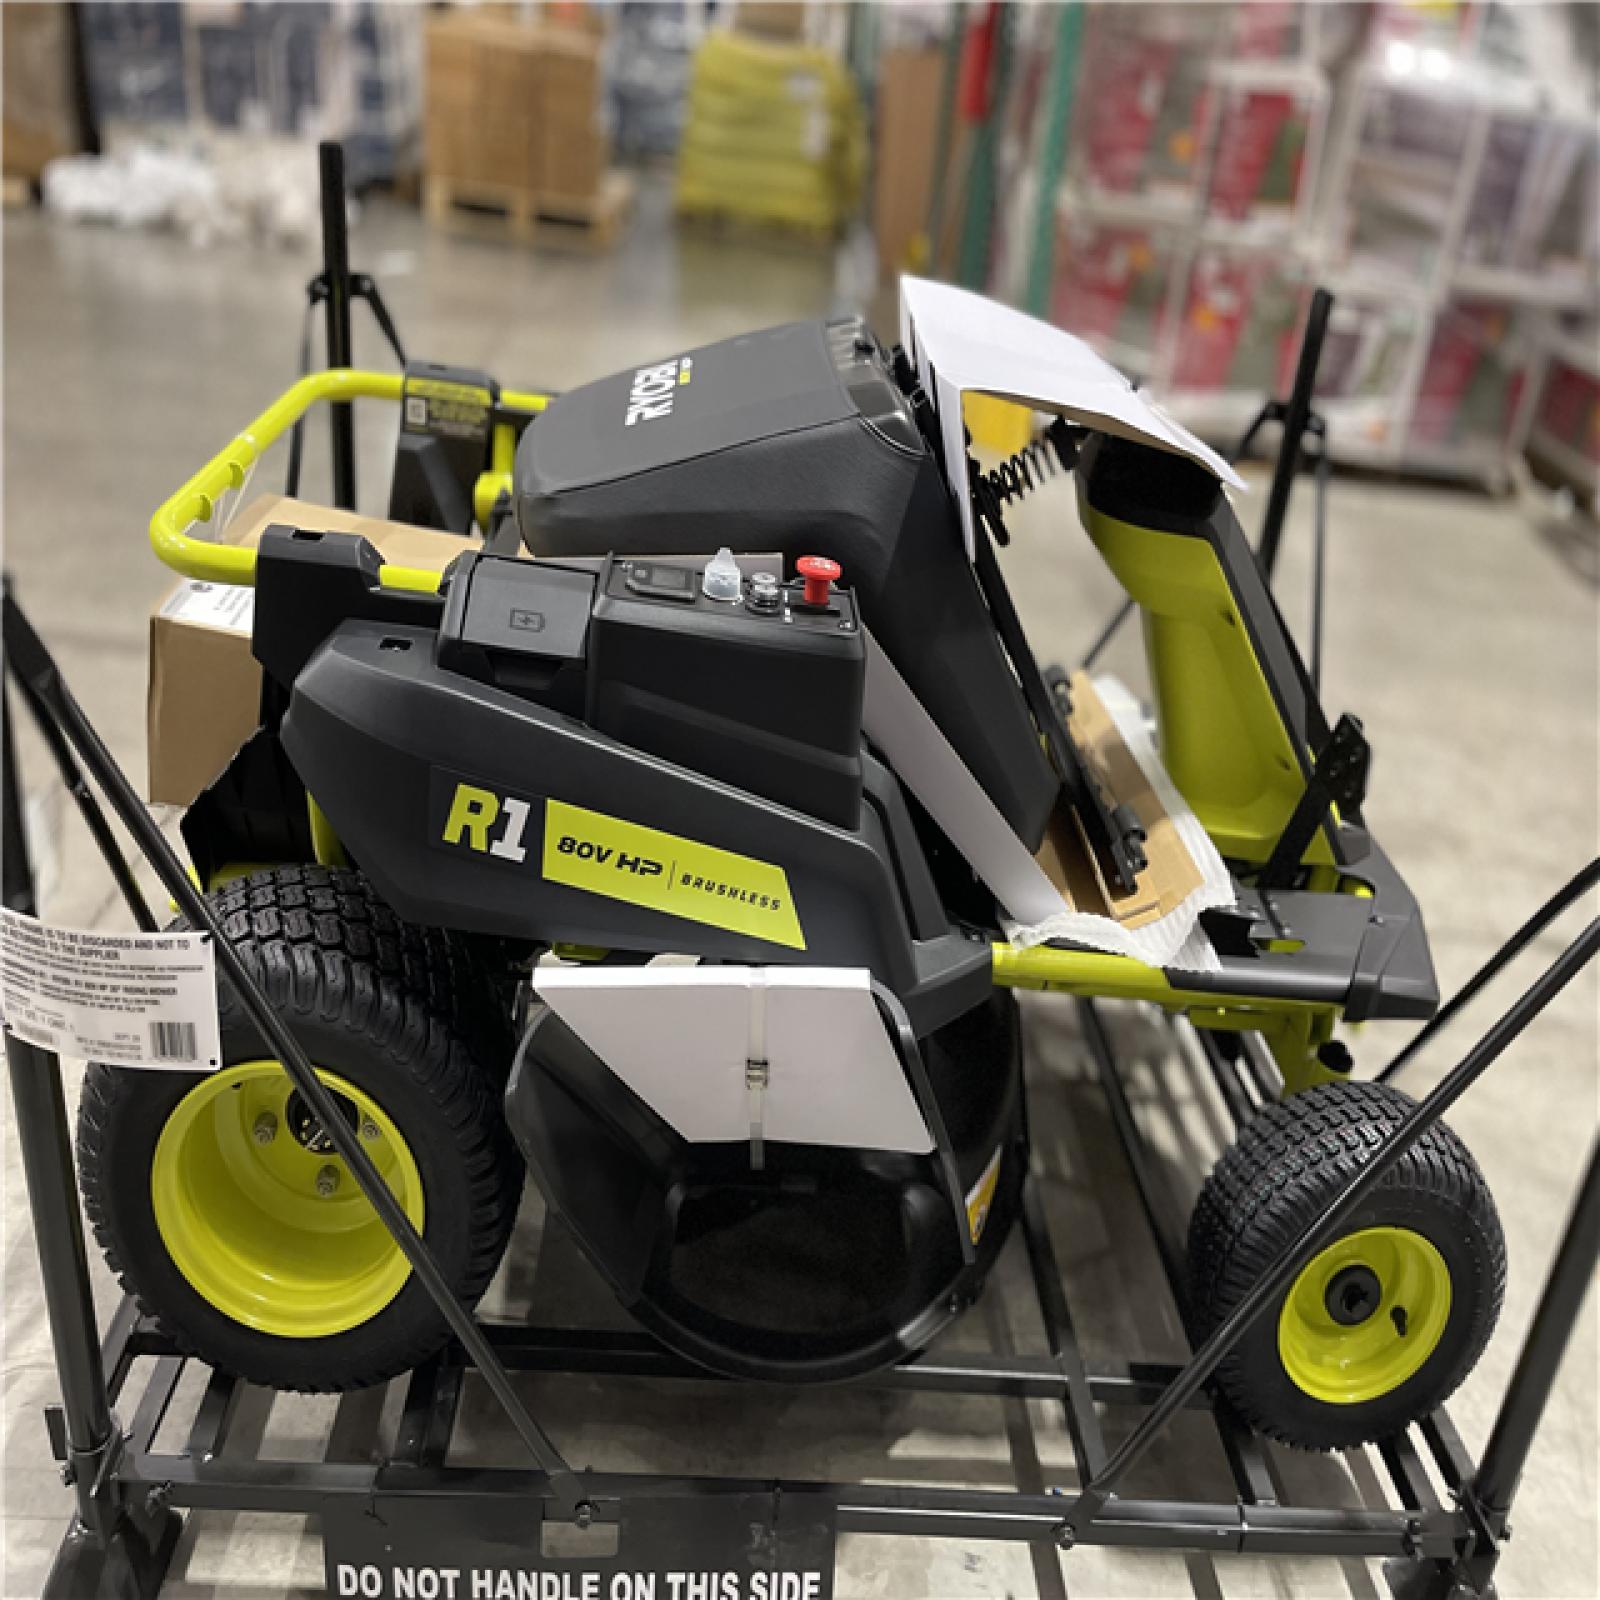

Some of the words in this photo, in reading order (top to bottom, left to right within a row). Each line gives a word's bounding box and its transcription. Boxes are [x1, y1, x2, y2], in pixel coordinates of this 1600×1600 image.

[624, 359, 678, 426] RYOBI
[442, 783, 531, 863] R1
[556, 835, 613, 864] 80V
[615, 852, 664, 876] HP
[680, 872, 782, 911] BRUSHLESS
[337, 1564, 382, 1599] DO
[392, 1566, 462, 1600] NOT
[471, 1569, 601, 1600] HANDLE
[610, 1571, 657, 1600] ON
[665, 1572, 741, 1600] THIS
[750, 1572, 821, 1600] SIDE
